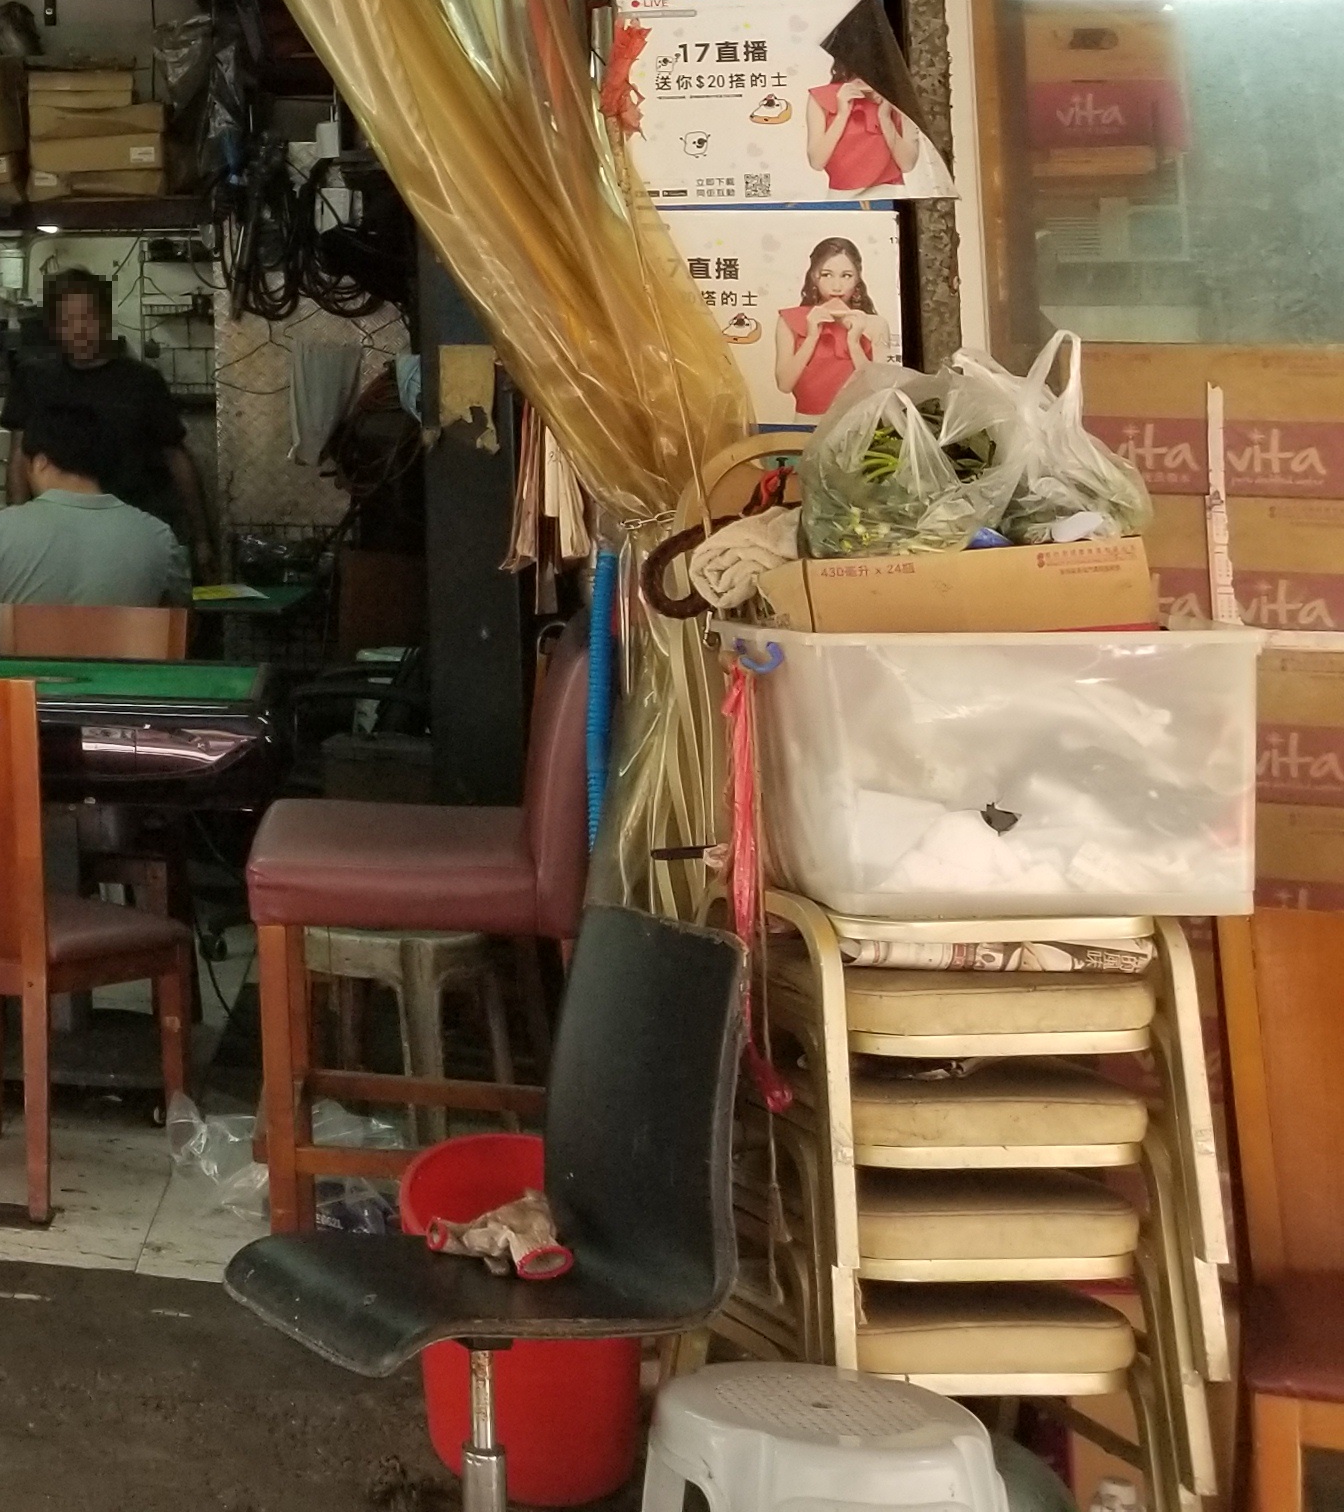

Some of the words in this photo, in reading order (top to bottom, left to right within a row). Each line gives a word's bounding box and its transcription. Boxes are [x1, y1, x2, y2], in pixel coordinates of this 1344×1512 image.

[643, 0, 669, 8] LIVE
[677, 40, 769, 64] 17直播
[1056, 92, 1126, 128] vita
[1226, 428, 1328, 477] vita
